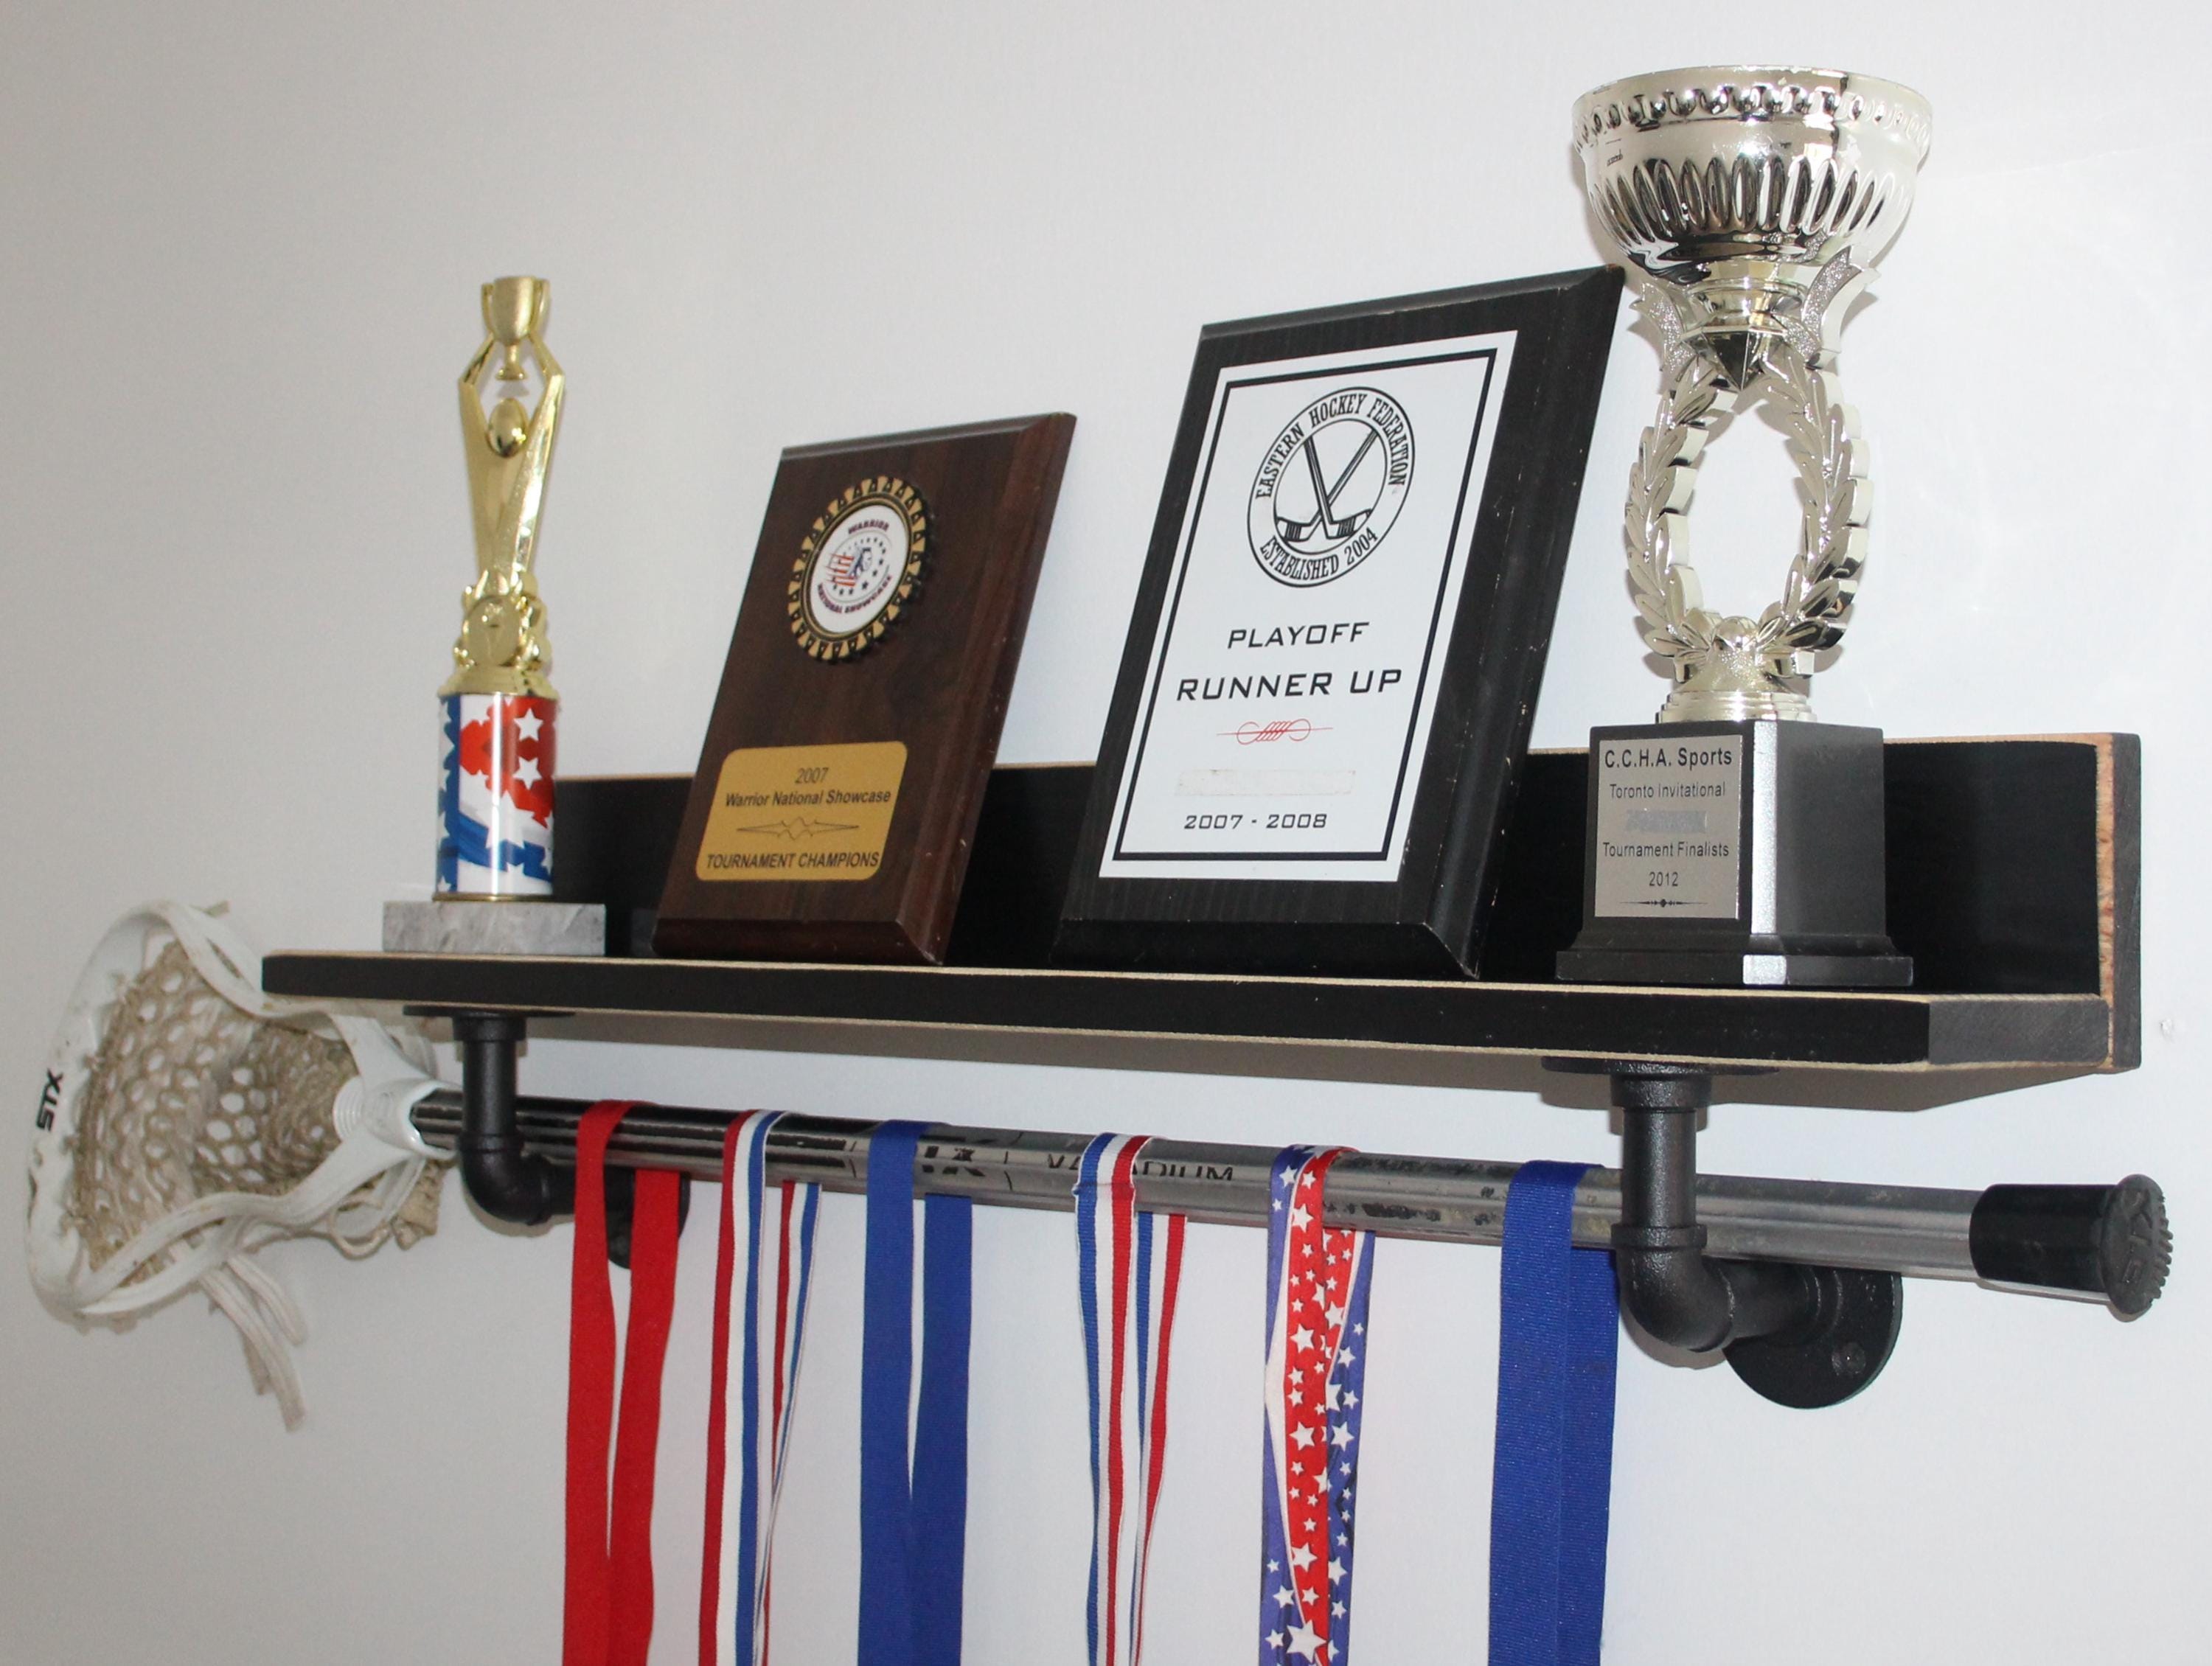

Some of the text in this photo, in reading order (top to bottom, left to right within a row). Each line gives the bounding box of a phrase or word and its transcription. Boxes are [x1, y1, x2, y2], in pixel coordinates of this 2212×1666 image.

[1255, 393, 1410, 499] EASTERN HOCKEY FEDERATION
[1259, 527, 1378, 581] ESTABLISHED 2004
[1227, 621, 1370, 649] PLAYOFF
[1176, 669, 1402, 701] RUNNER UP
[1604, 747, 1733, 771] C.C.H.A. Sports
[794, 767, 829, 784] 2007
[725, 789, 891, 807] Warrior National Showcase
[1610, 781, 1726, 799] Toronto Invitational
[1183, 815, 1244, 829] 2007
[1266, 813, 1328, 829] 2008
[1603, 841, 1730, 857] Tournament Finalists
[706, 851, 881, 869] TOURNAMENT CHAMPIONS
[1649, 871, 1679, 888] 2012
[36, 1068, 64, 1132] STX
